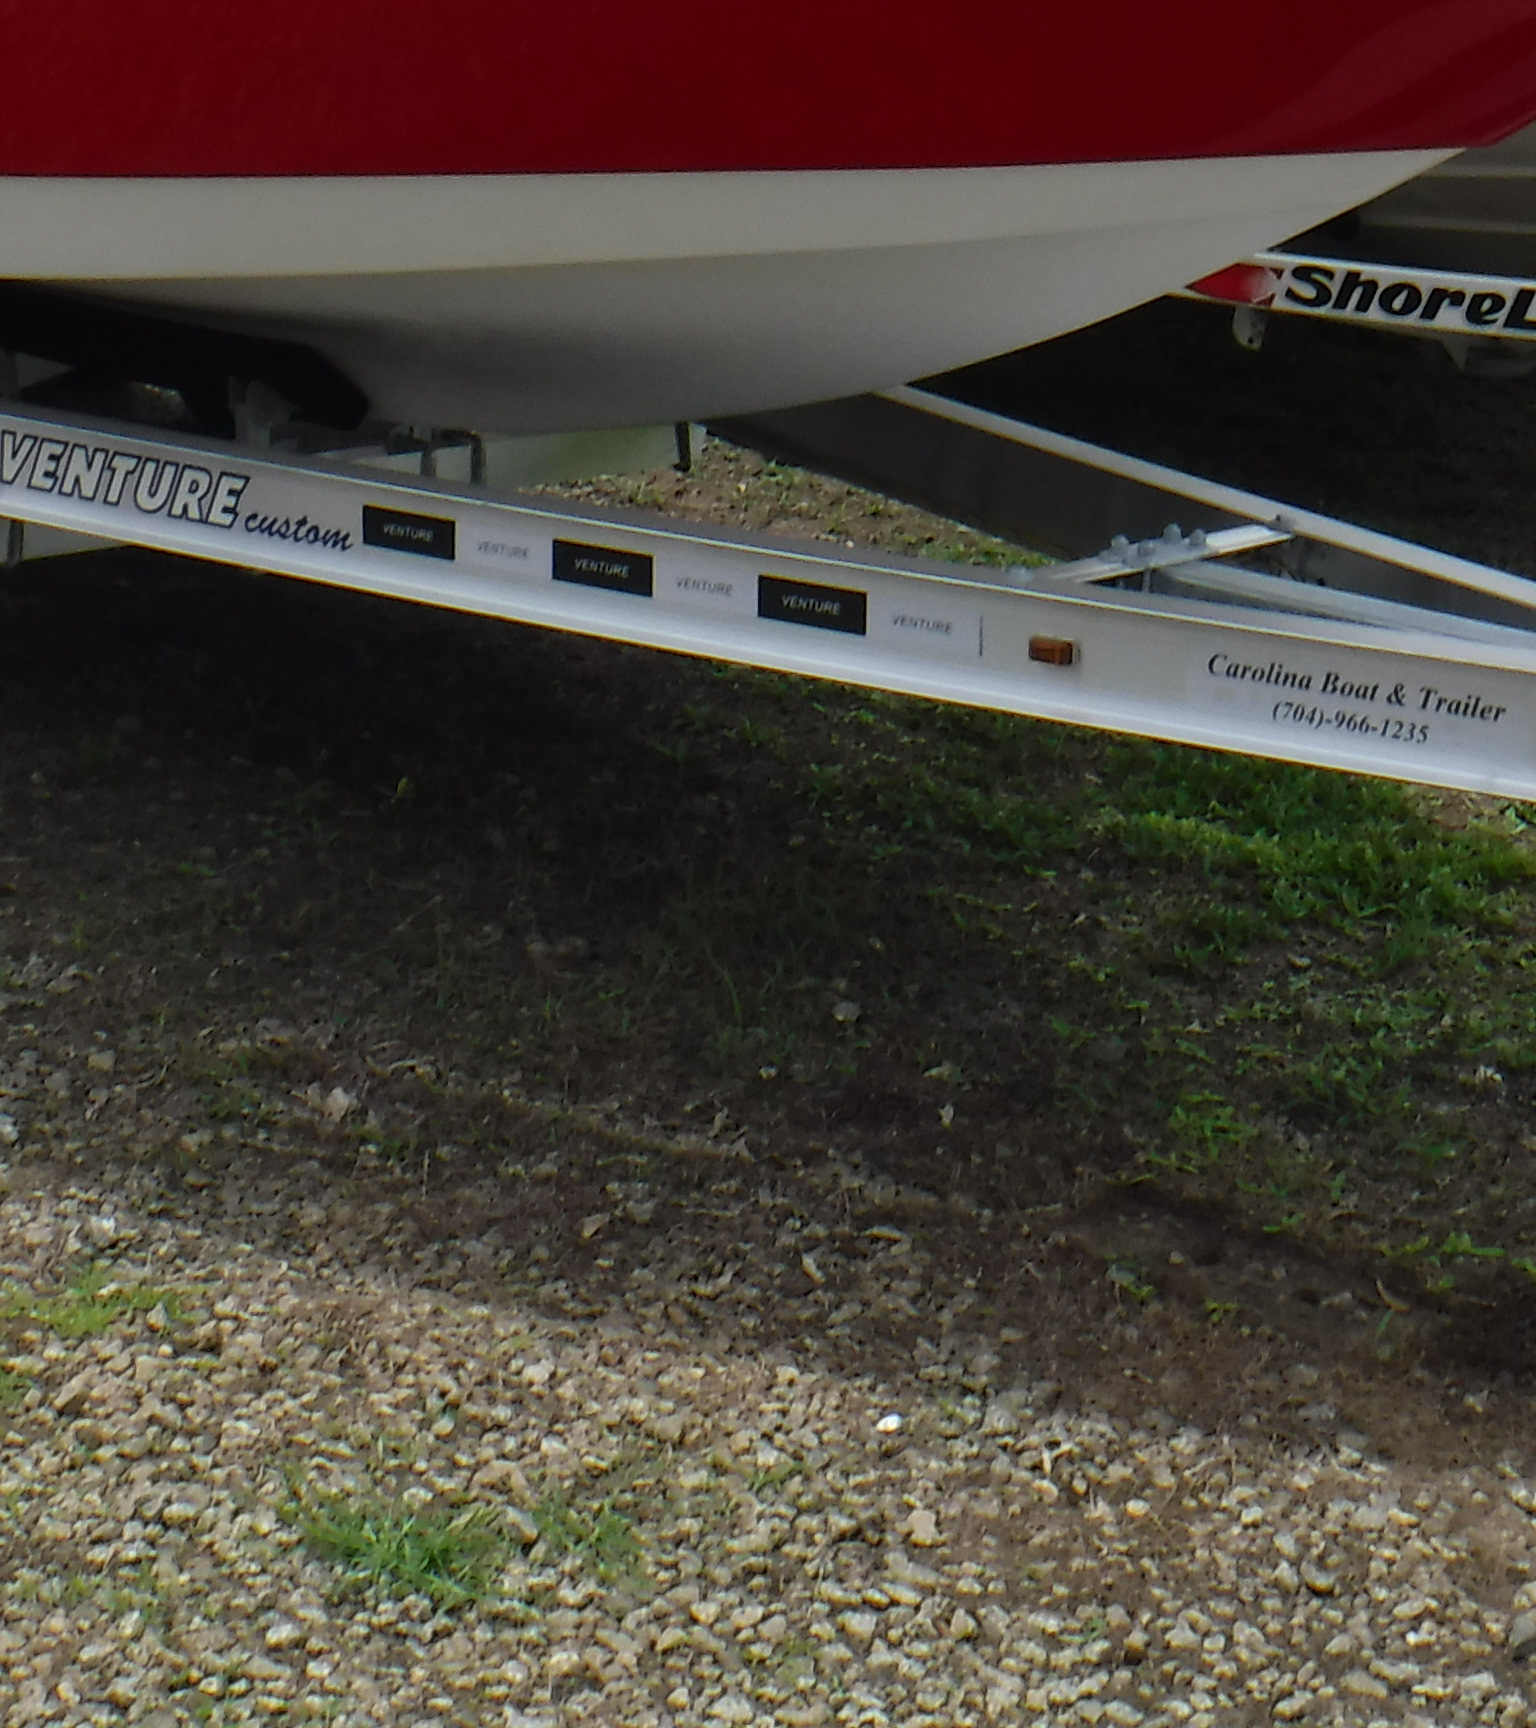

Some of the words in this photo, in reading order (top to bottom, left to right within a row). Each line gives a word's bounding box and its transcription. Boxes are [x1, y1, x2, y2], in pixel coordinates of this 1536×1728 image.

[0, 429, 252, 530] VENTURE
[244, 509, 355, 553] custom
[382, 523, 435, 543] VENTURE
[477, 540, 531, 560] VENTURE
[573, 558, 631, 580] VENTURE
[676, 576, 734, 597] VENTURE
[780, 593, 842, 617] VENTURE
[891, 613, 953, 635] VENTURE
[1207, 652, 1313, 692] Carolina
[1320, 671, 1381, 702] Boat
[1386, 683, 1408, 707] &
[1418, 685, 1507, 723] Trailer
[1271, 700, 1430, 744] (704)-966-1235
